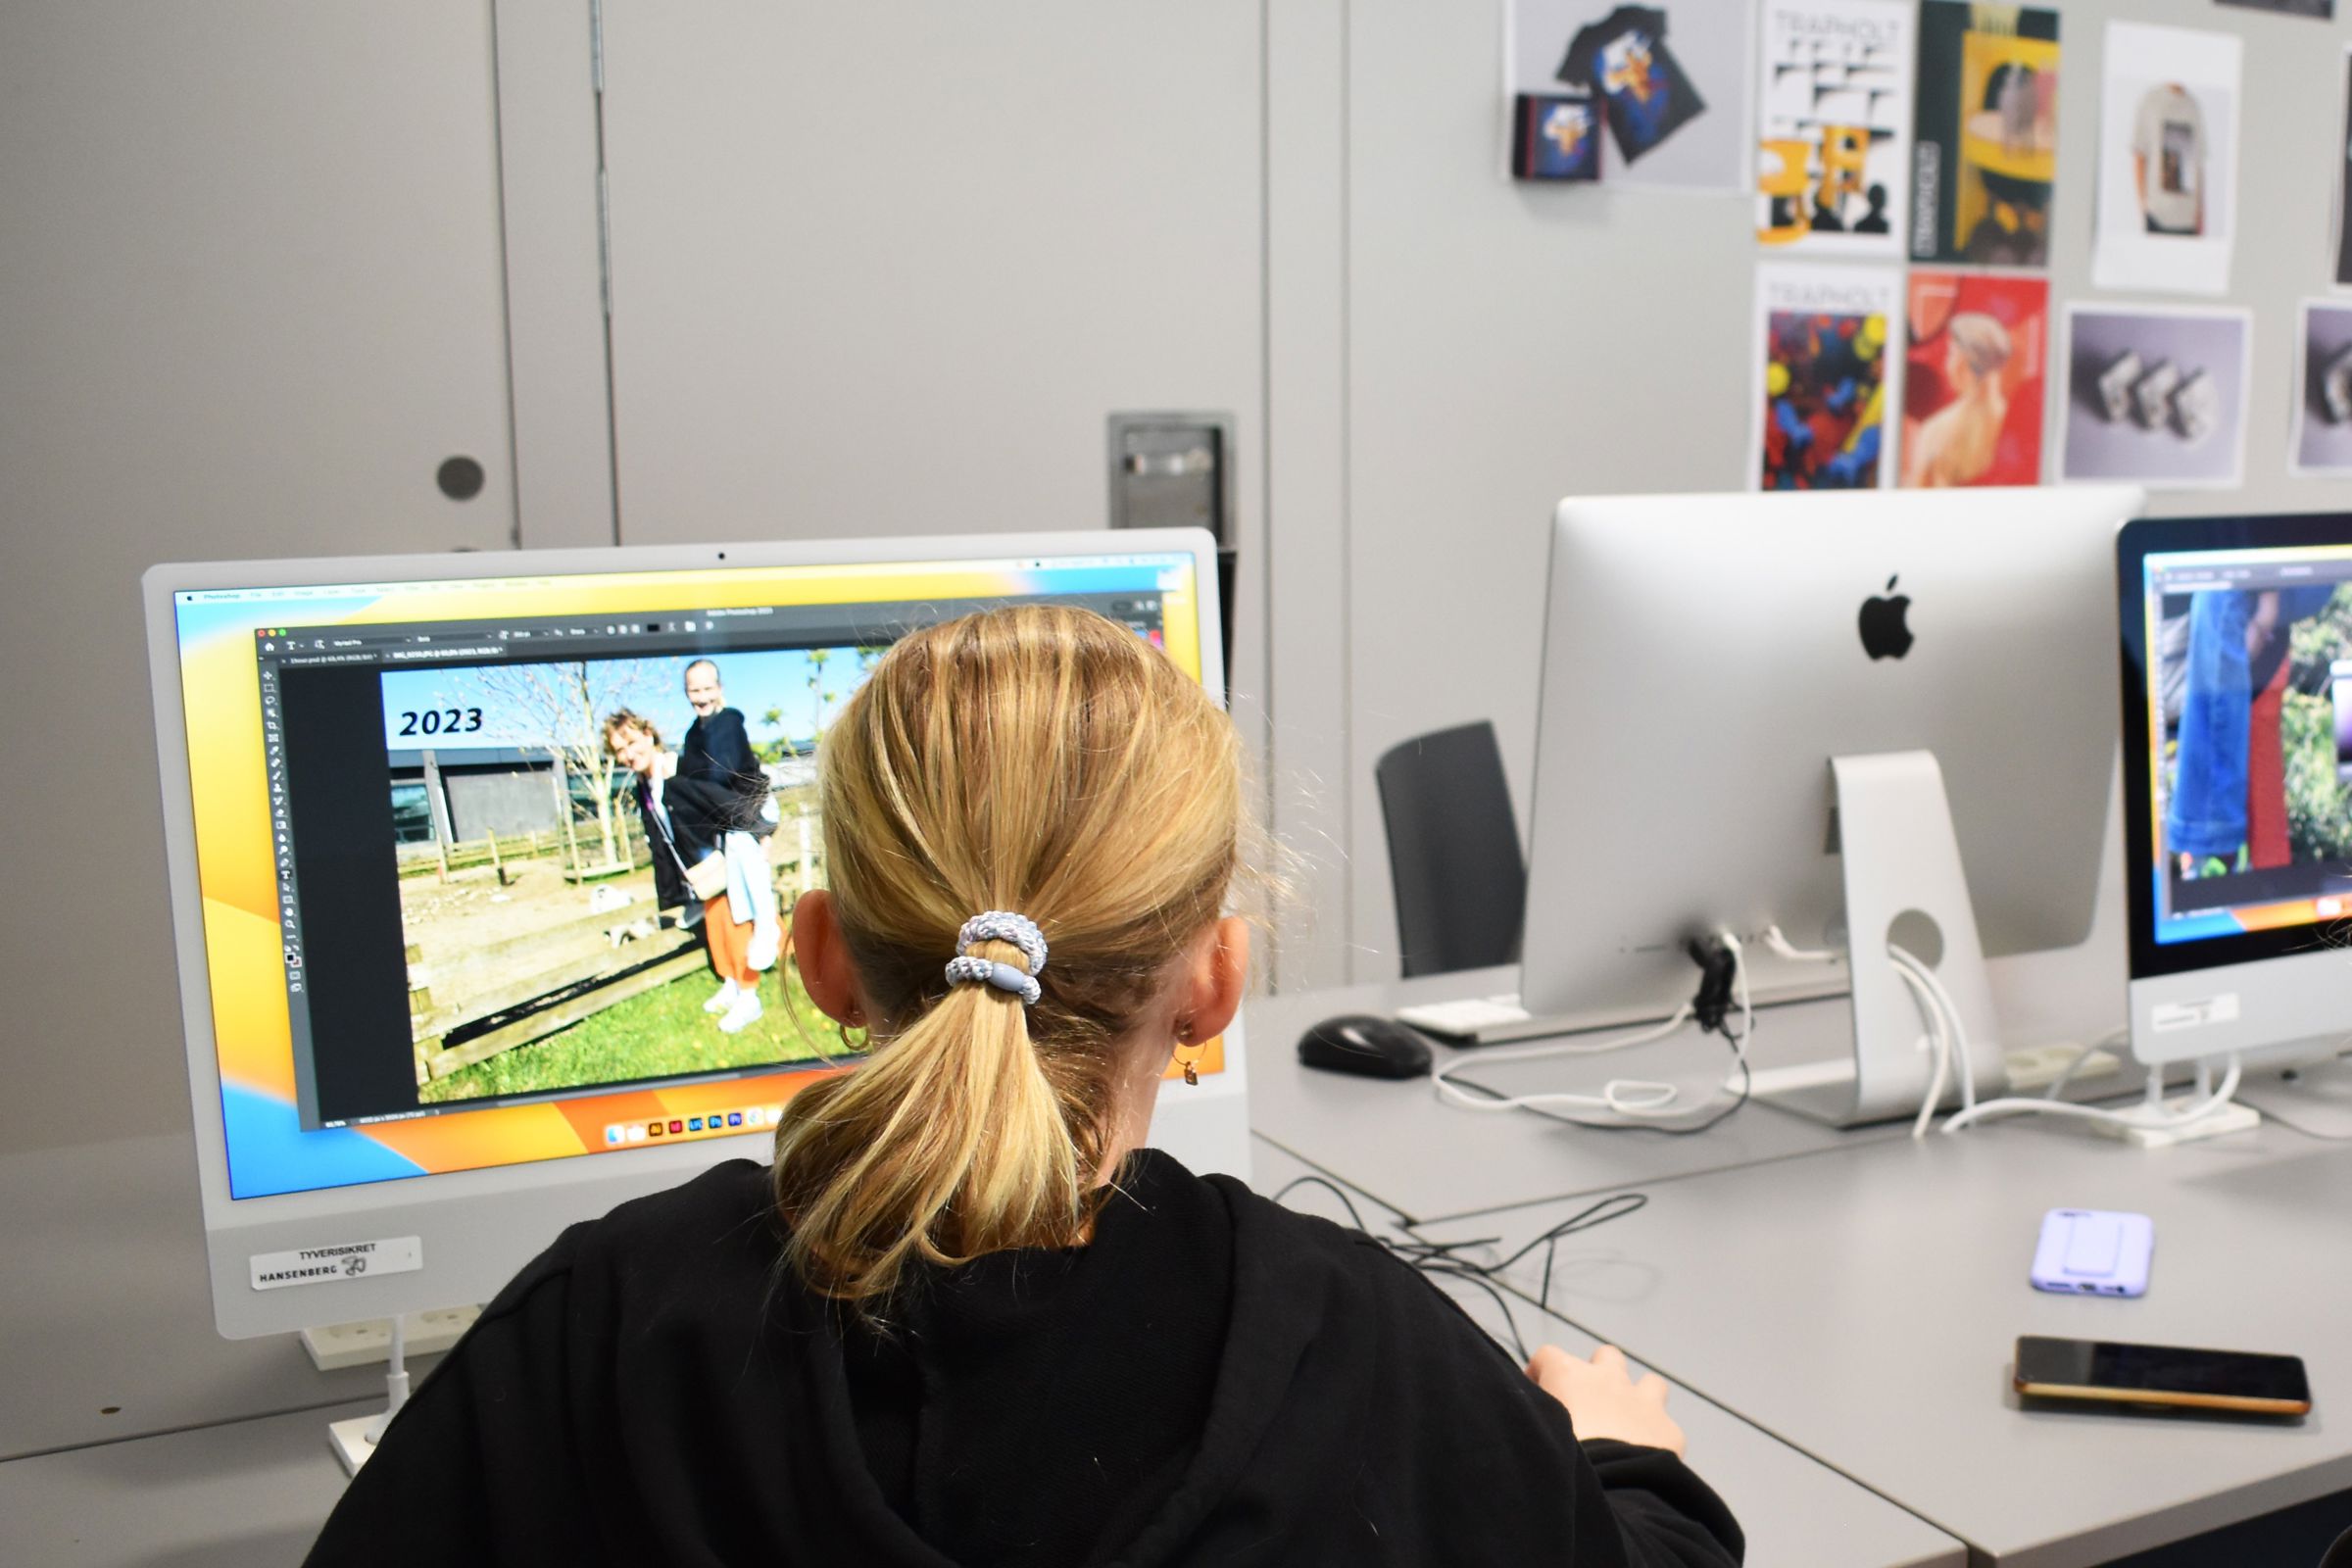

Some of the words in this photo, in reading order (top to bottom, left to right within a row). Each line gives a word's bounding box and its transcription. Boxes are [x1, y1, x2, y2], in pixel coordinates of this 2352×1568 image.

[399, 708, 482, 736] 2023
[299, 1244, 376, 1259] TYVERISIKRET
[260, 1265, 337, 1282] HANSENBERG
